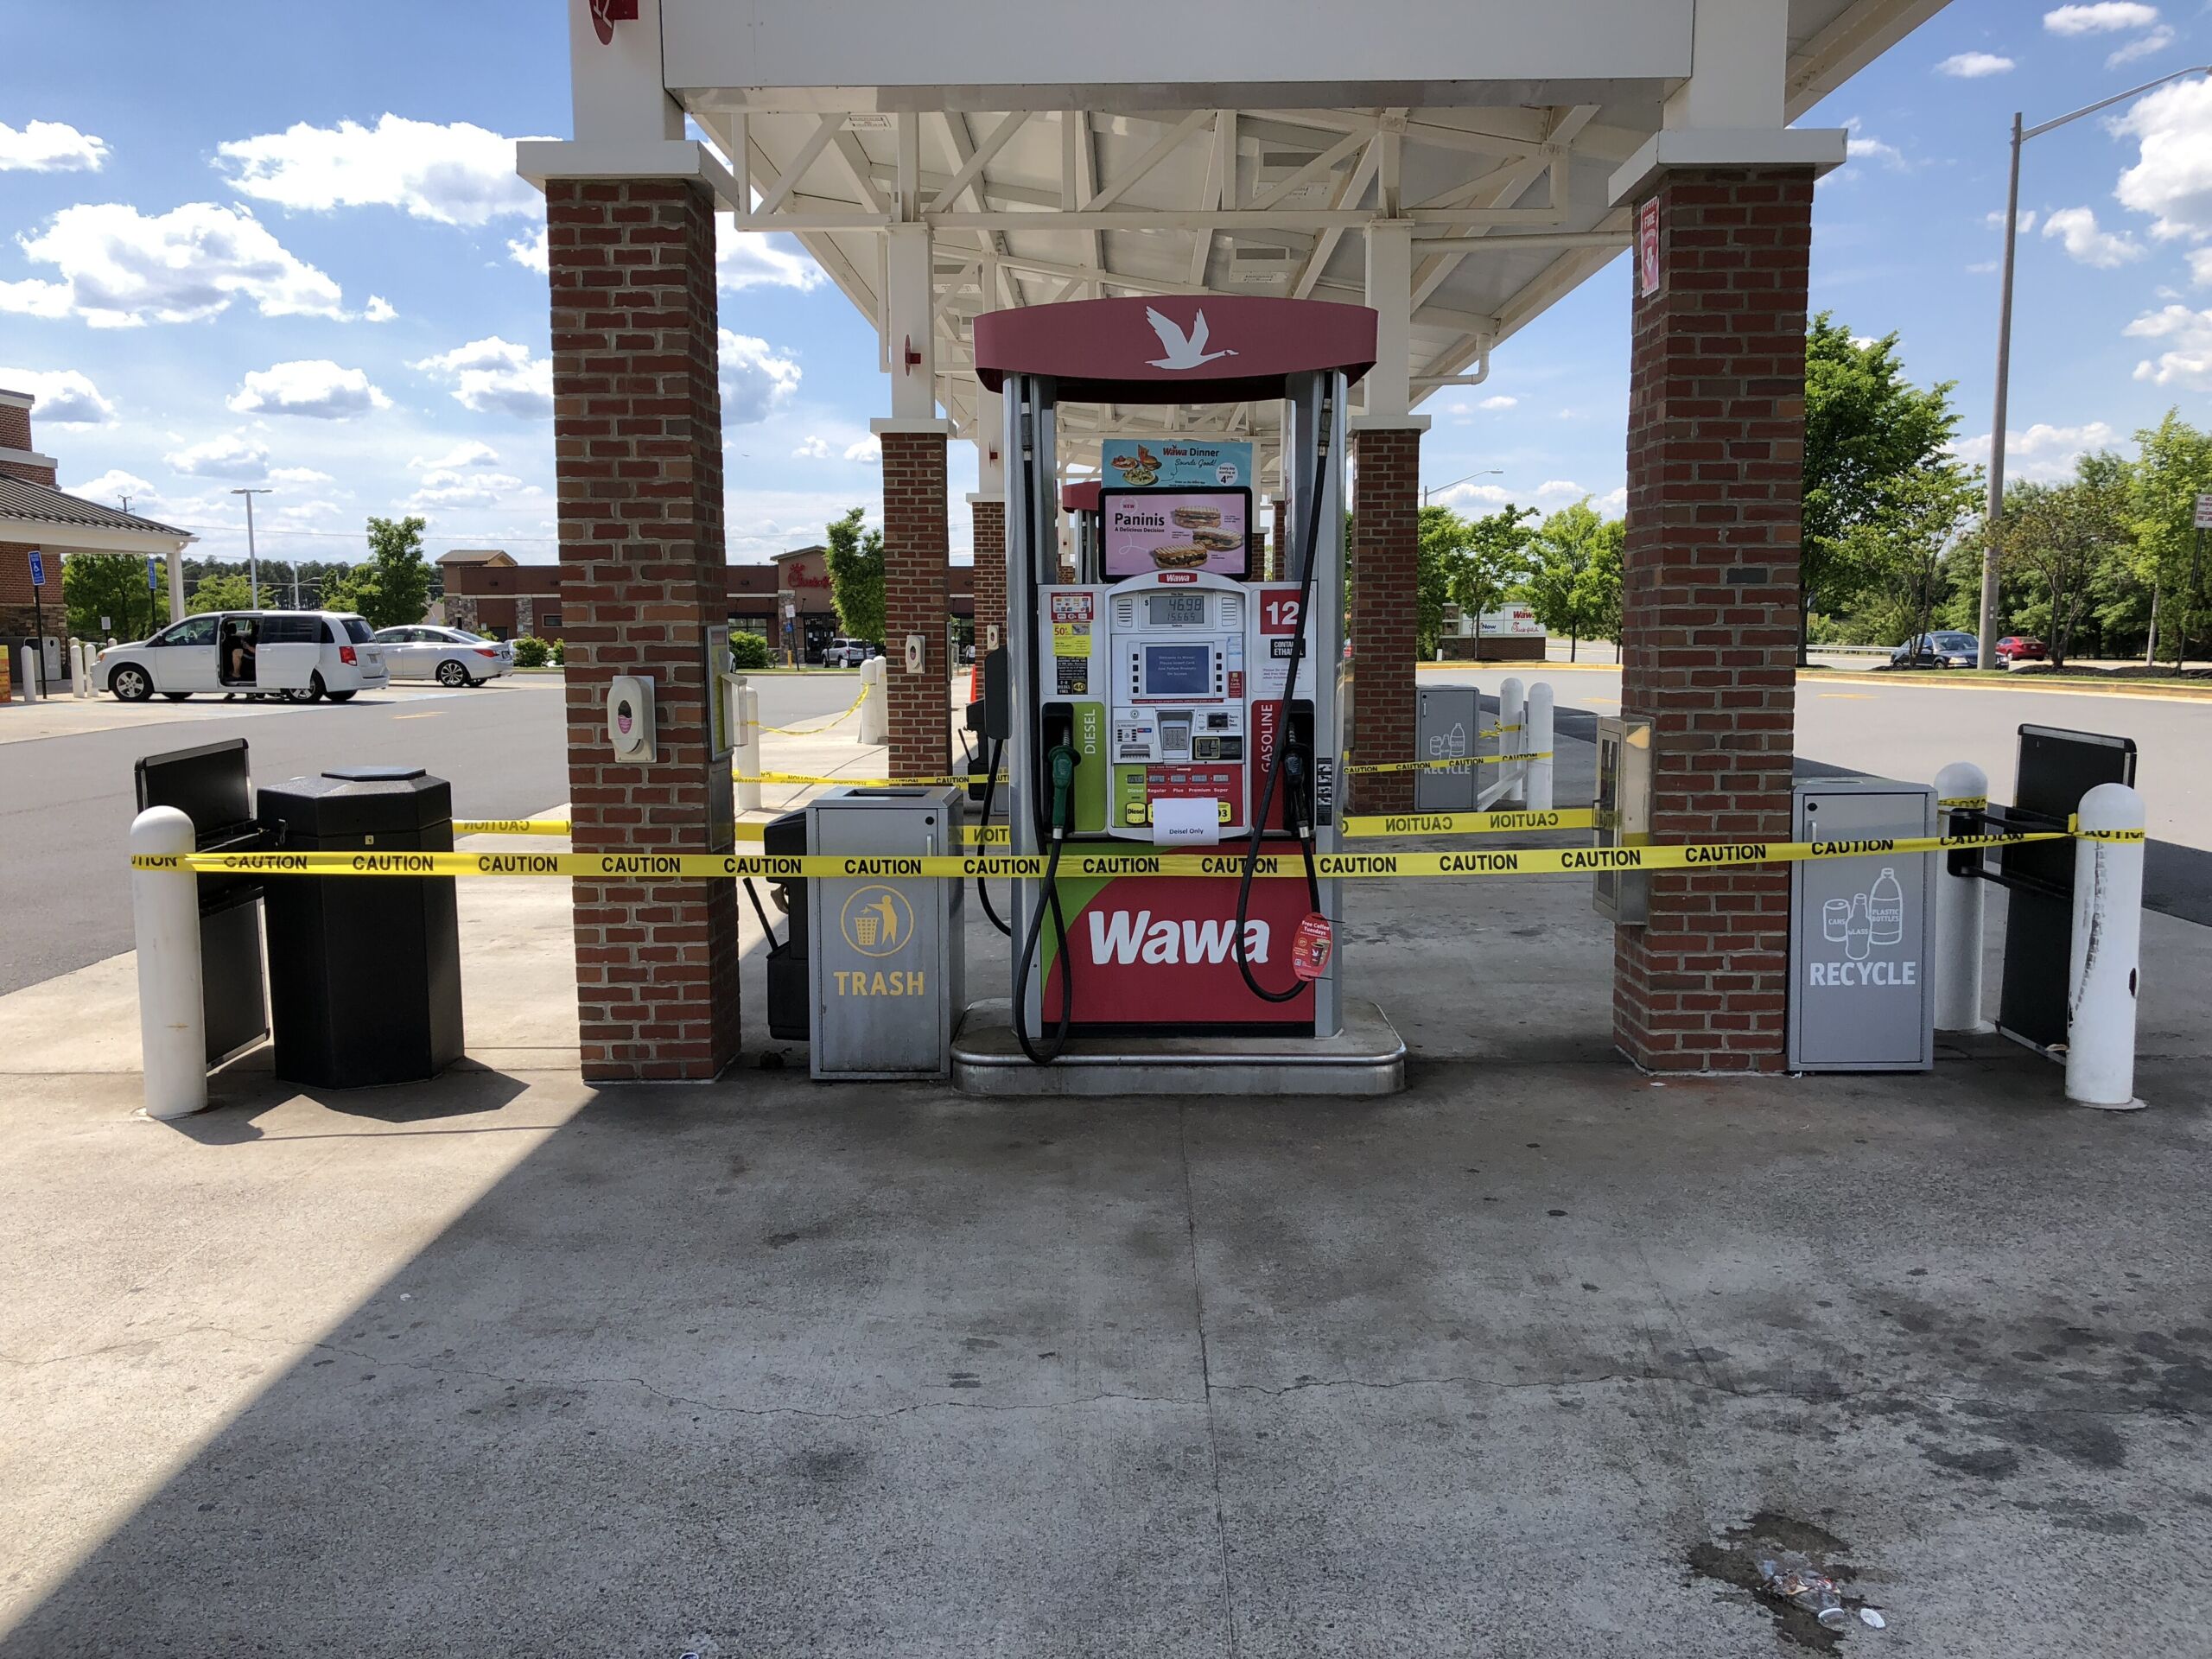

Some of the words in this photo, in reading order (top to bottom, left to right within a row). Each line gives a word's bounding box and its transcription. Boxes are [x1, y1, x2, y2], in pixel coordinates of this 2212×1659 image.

[1163, 446, 1187, 456] Wawa
[1189, 448, 1220, 457] Dinner
[1175, 458, 1196, 467] Sounds
[1198, 459, 1217, 468] Good!
[1220, 475, 1227, 484] 4
[1115, 512, 1165, 526] Paninis
[1166, 574, 1190, 582] Wawa
[1266, 601, 1300, 626] 12
[1084, 709, 1096, 754] DIESEL
[1261, 704, 1273, 772] GASOLINE
[1503, 753, 1537, 761] CAUTION
[1396, 762, 1431, 771] CAUTION
[1449, 758, 1484, 767] CAUTION
[224, 855, 307, 870] CAUTION
[353, 855, 433, 871] CAUTION
[478, 856, 558, 872] CAUTION
[602, 857, 680, 873] CAUTION
[724, 858, 802, 874] CAUTION
[844, 859, 922, 874] CAUTION
[964, 859, 1040, 874] CAUTION
[1083, 858, 1159, 873] CAUTION
[1201, 858, 1278, 873] CAUTON
[1320, 857, 1397, 873] CAUTION
[1440, 854, 1518, 871] CAUTION
[1561, 849, 1641, 868] CAUTION
[1685, 845, 1766, 862] CAUTION
[1812, 839, 1894, 855] CAUTION
[1303, 926, 1326, 935] Tuesdays
[1313, 923, 1330, 931] Coffee
[1088, 910, 1271, 966] Wawa
[1809, 961, 1916, 986] RECYCLE
[833, 971, 925, 996] TRASH
